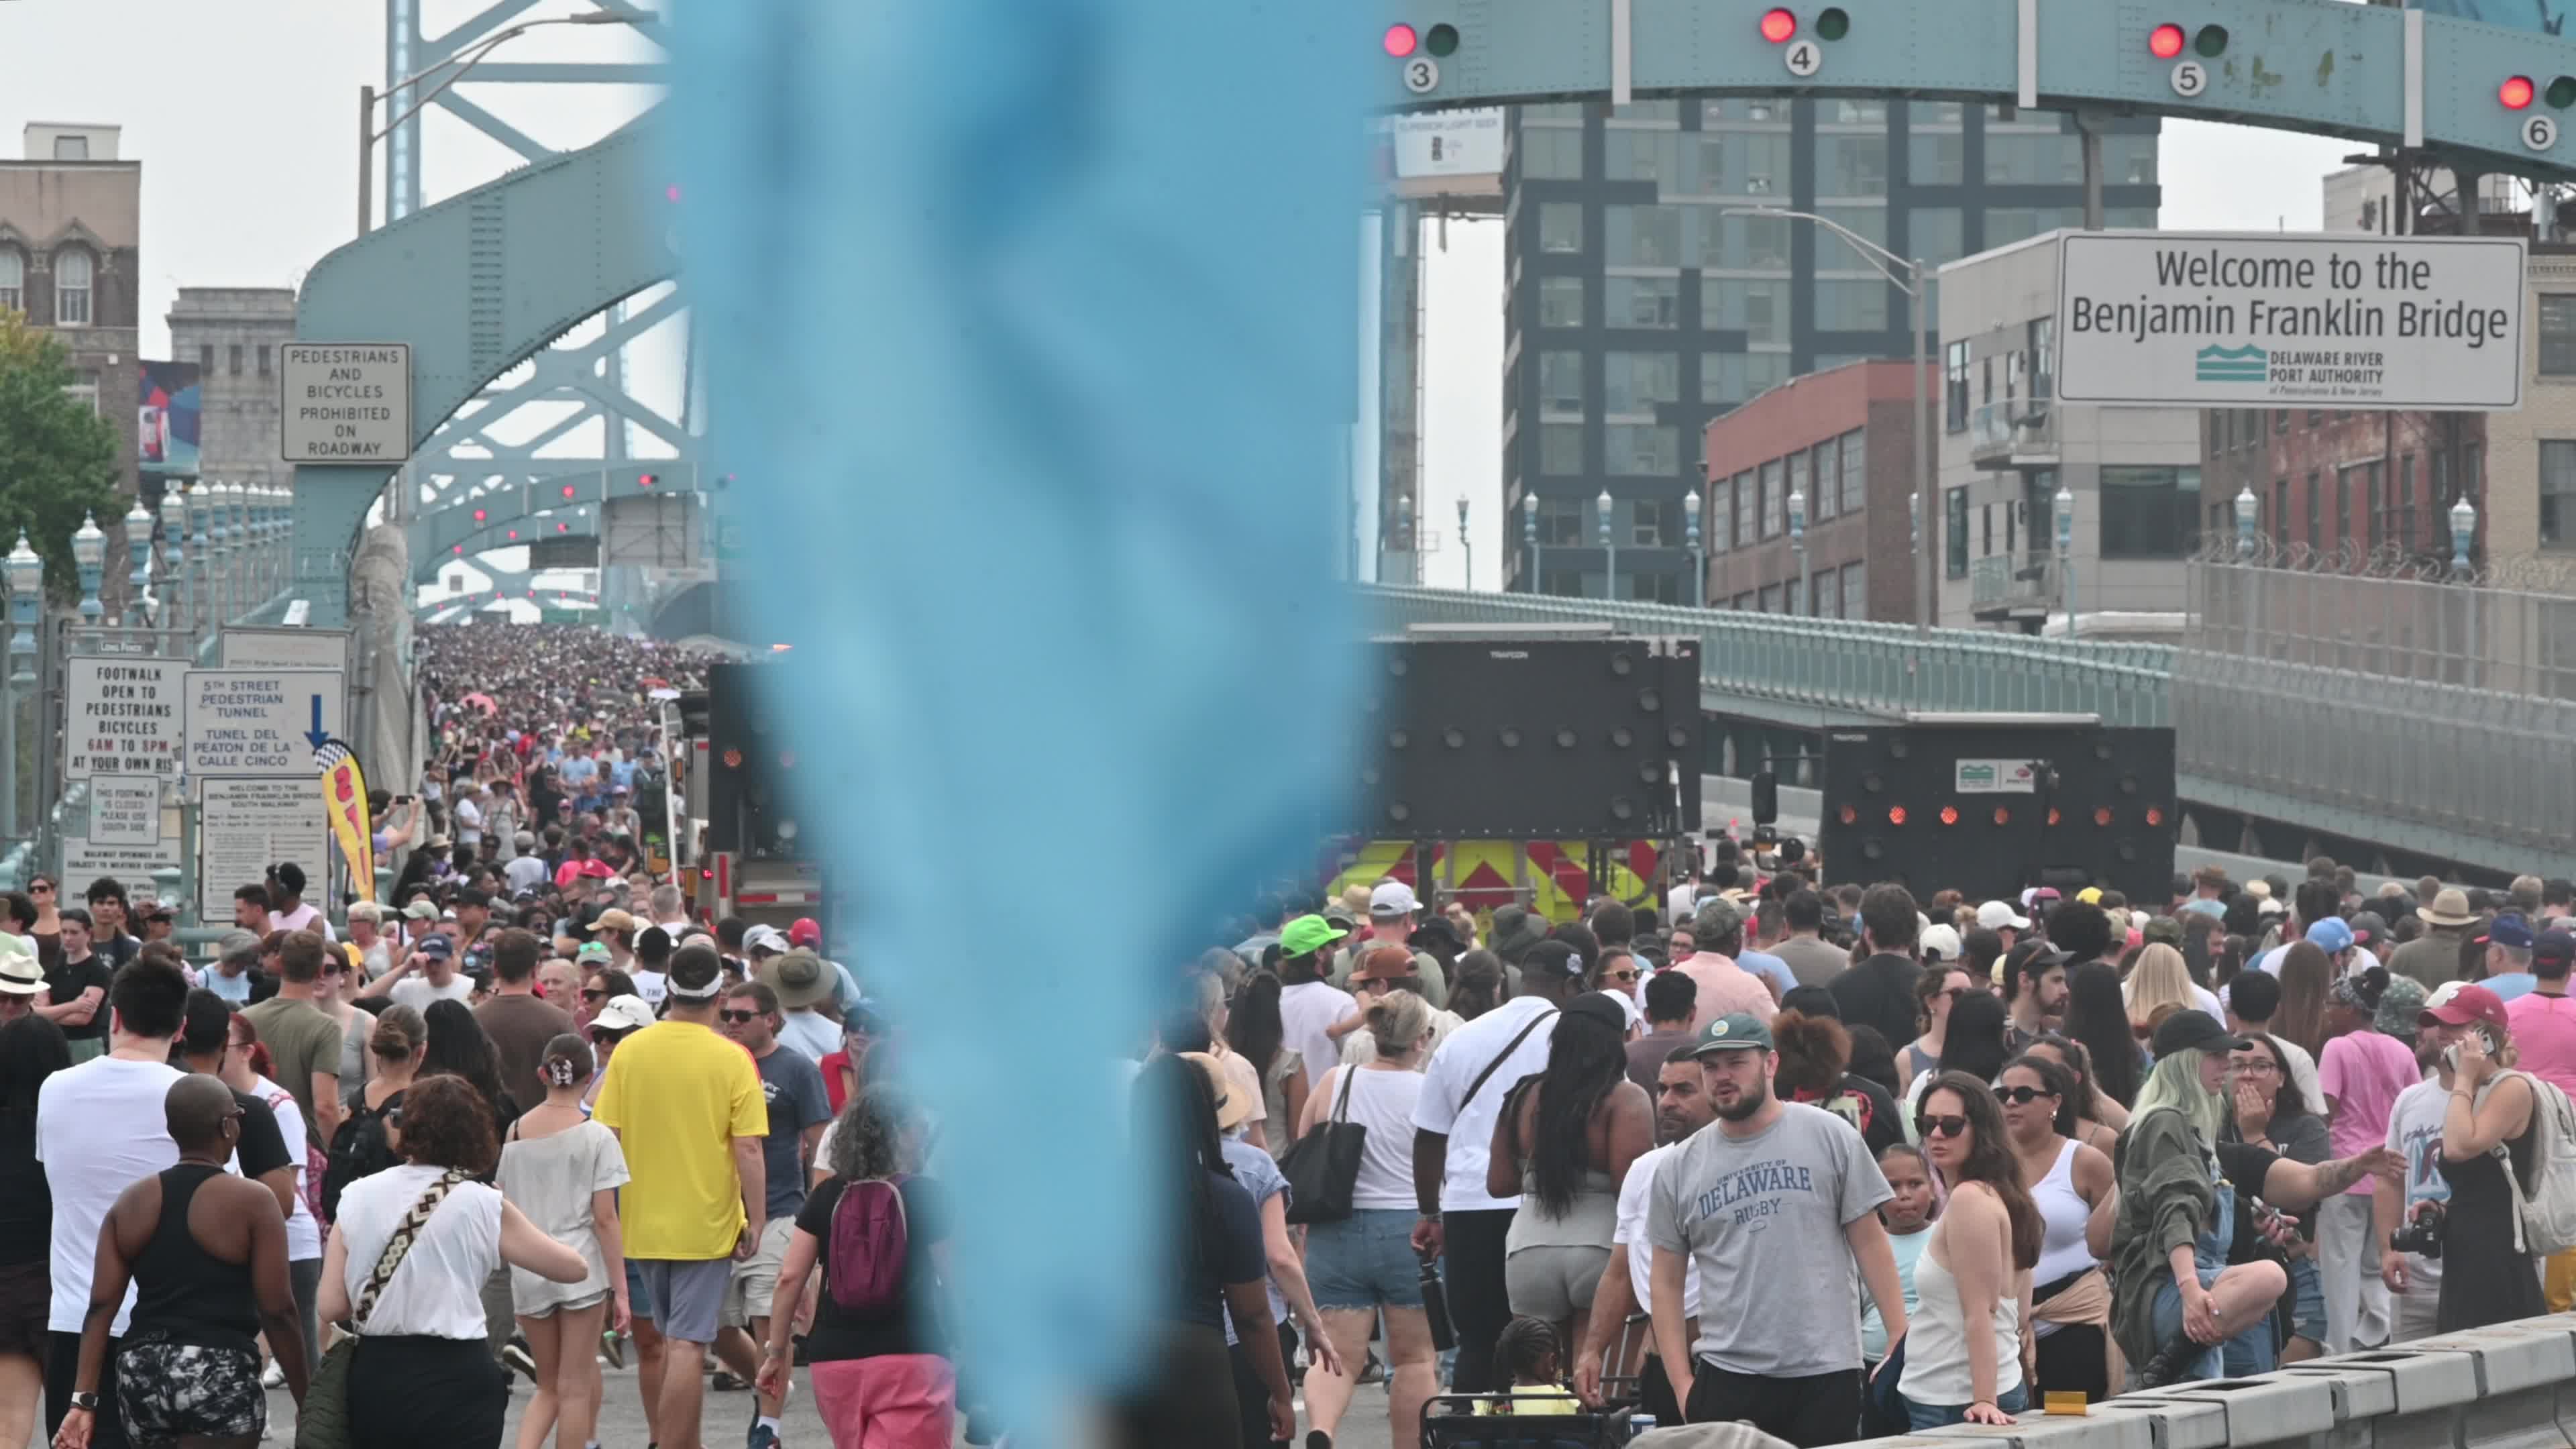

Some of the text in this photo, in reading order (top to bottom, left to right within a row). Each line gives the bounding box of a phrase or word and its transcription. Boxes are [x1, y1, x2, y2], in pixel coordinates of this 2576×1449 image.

[1792, 46, 1811, 69] 4
[1411, 62, 1430, 87] 3
[2180, 66, 2197, 91] 5
[2530, 120, 2548, 145] 6
[2156, 249, 2430, 290] Welcome to the
[2072, 294, 2508, 349] Benjamin Franklin Bridge
[290, 350, 398, 364] PEDESTRIANS
[2270, 351, 2383, 366] DELAWARE RIVER
[329, 368, 362, 381] AND
[2270, 368, 2384, 384] PORT AUTHORITY
[307, 385, 383, 398] BICYCLES
[300, 407, 390, 420] PROHIBITED
[335, 424, 356, 437] ON
[308, 442, 381, 455] ROADWAY
[97, 667, 161, 680] FOOTWALK
[102, 686, 156, 699] OPEN TO
[203, 680, 280, 692] 5TH STREET
[201, 694, 283, 704] PEDESTRIAN
[86, 703, 171, 717] PEDESTRIANS
[216, 707, 268, 718] TUNNEL
[99, 720, 158, 735] BICYCLES
[205, 729, 279, 739] TUNEL DEL
[121, 739, 135, 752] TO
[193, 742, 290, 753] PEATON DE LA
[72, 756, 172, 771] AT YOUR OWN RIS
[197, 755, 288, 766] CALLE CINCO
[1717, 1161, 1772, 1184] UNIVERSITY
[1699, 1166, 1812, 1220] DELAWARE
